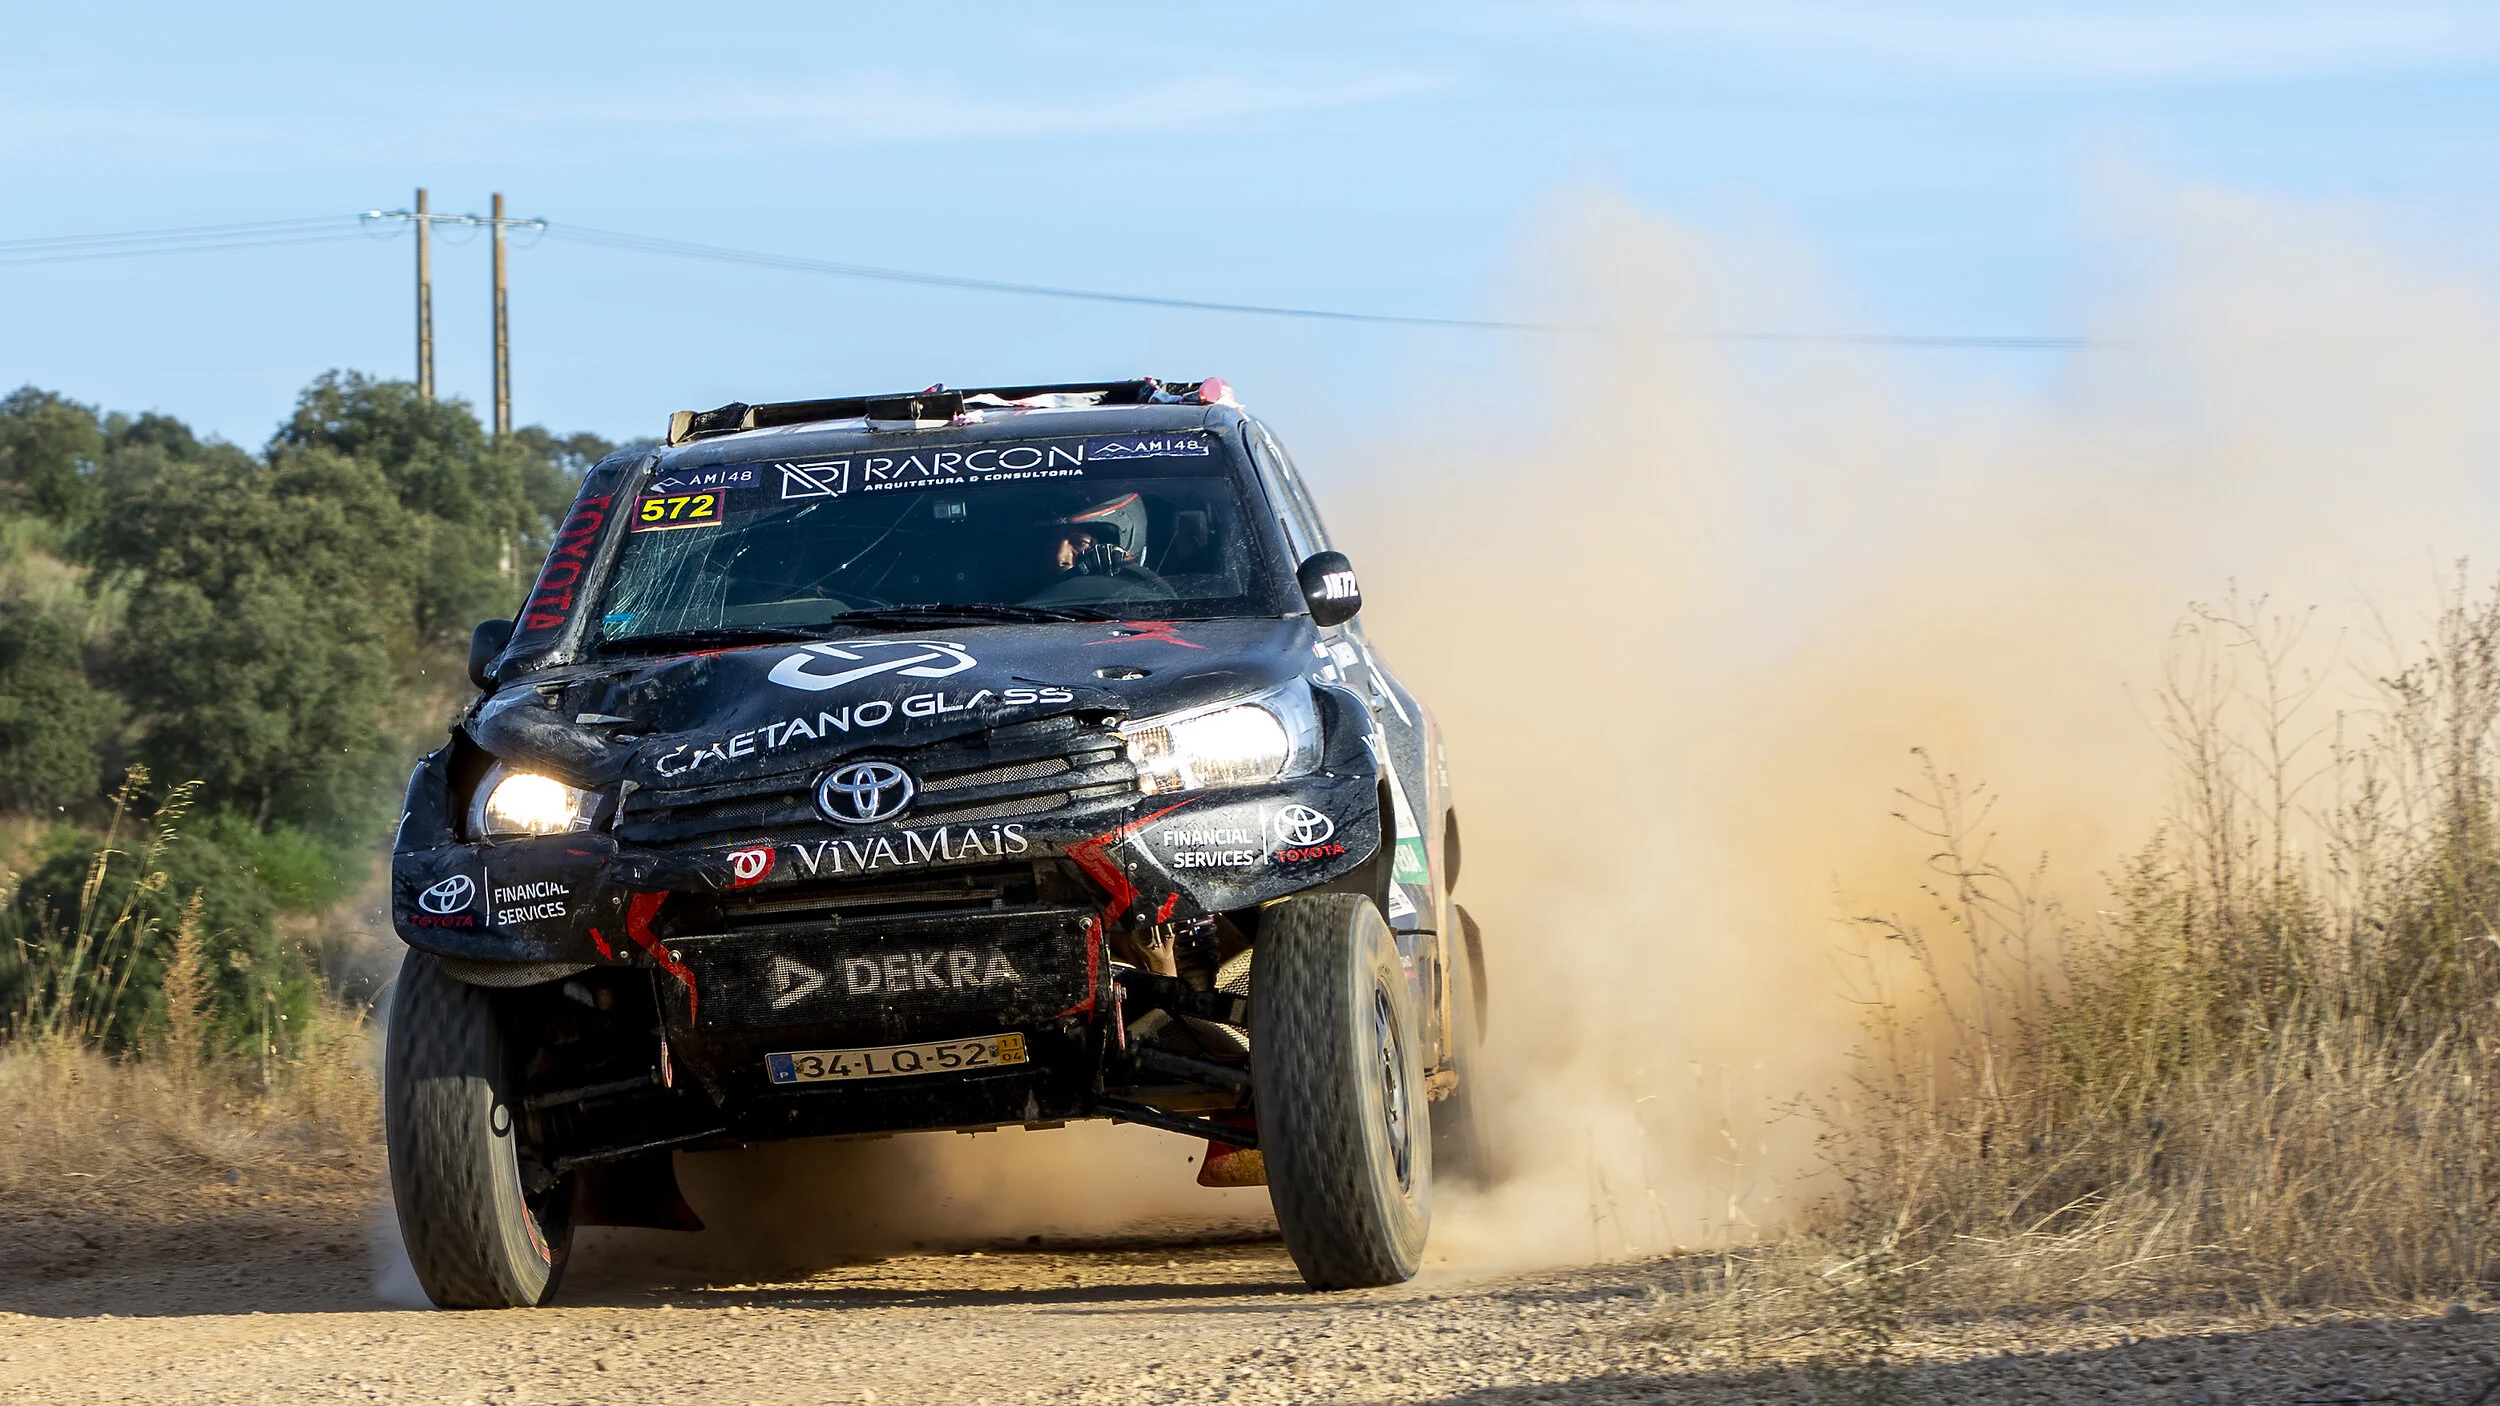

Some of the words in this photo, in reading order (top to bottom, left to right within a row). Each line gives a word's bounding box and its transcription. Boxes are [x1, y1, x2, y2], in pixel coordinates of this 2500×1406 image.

[864, 445, 1084, 482] RARCON
[863, 476, 965, 492] ARQUITETURA
[984, 469, 1084, 482] CONSULTORIA
[641, 494, 715, 522] 572
[523, 494, 614, 630] TOYOTA
[656, 700, 893, 778] CAETANO
[901, 687, 1074, 719] GLASS
[1163, 828, 1253, 846] FINANCIAL
[1173, 848, 1254, 868] SERVICES
[1275, 843, 1346, 864] TOYOTA
[494, 881, 569, 904] FINANCIAL
[410, 914, 473, 927] TOYOTA
[497, 901, 566, 926] SERVICES
[844, 950, 1021, 995] DEKRA
[1001, 1038, 1018, 1046] 11
[1002, 1051, 1022, 1062] 04
[779, 1071, 789, 1079] P
